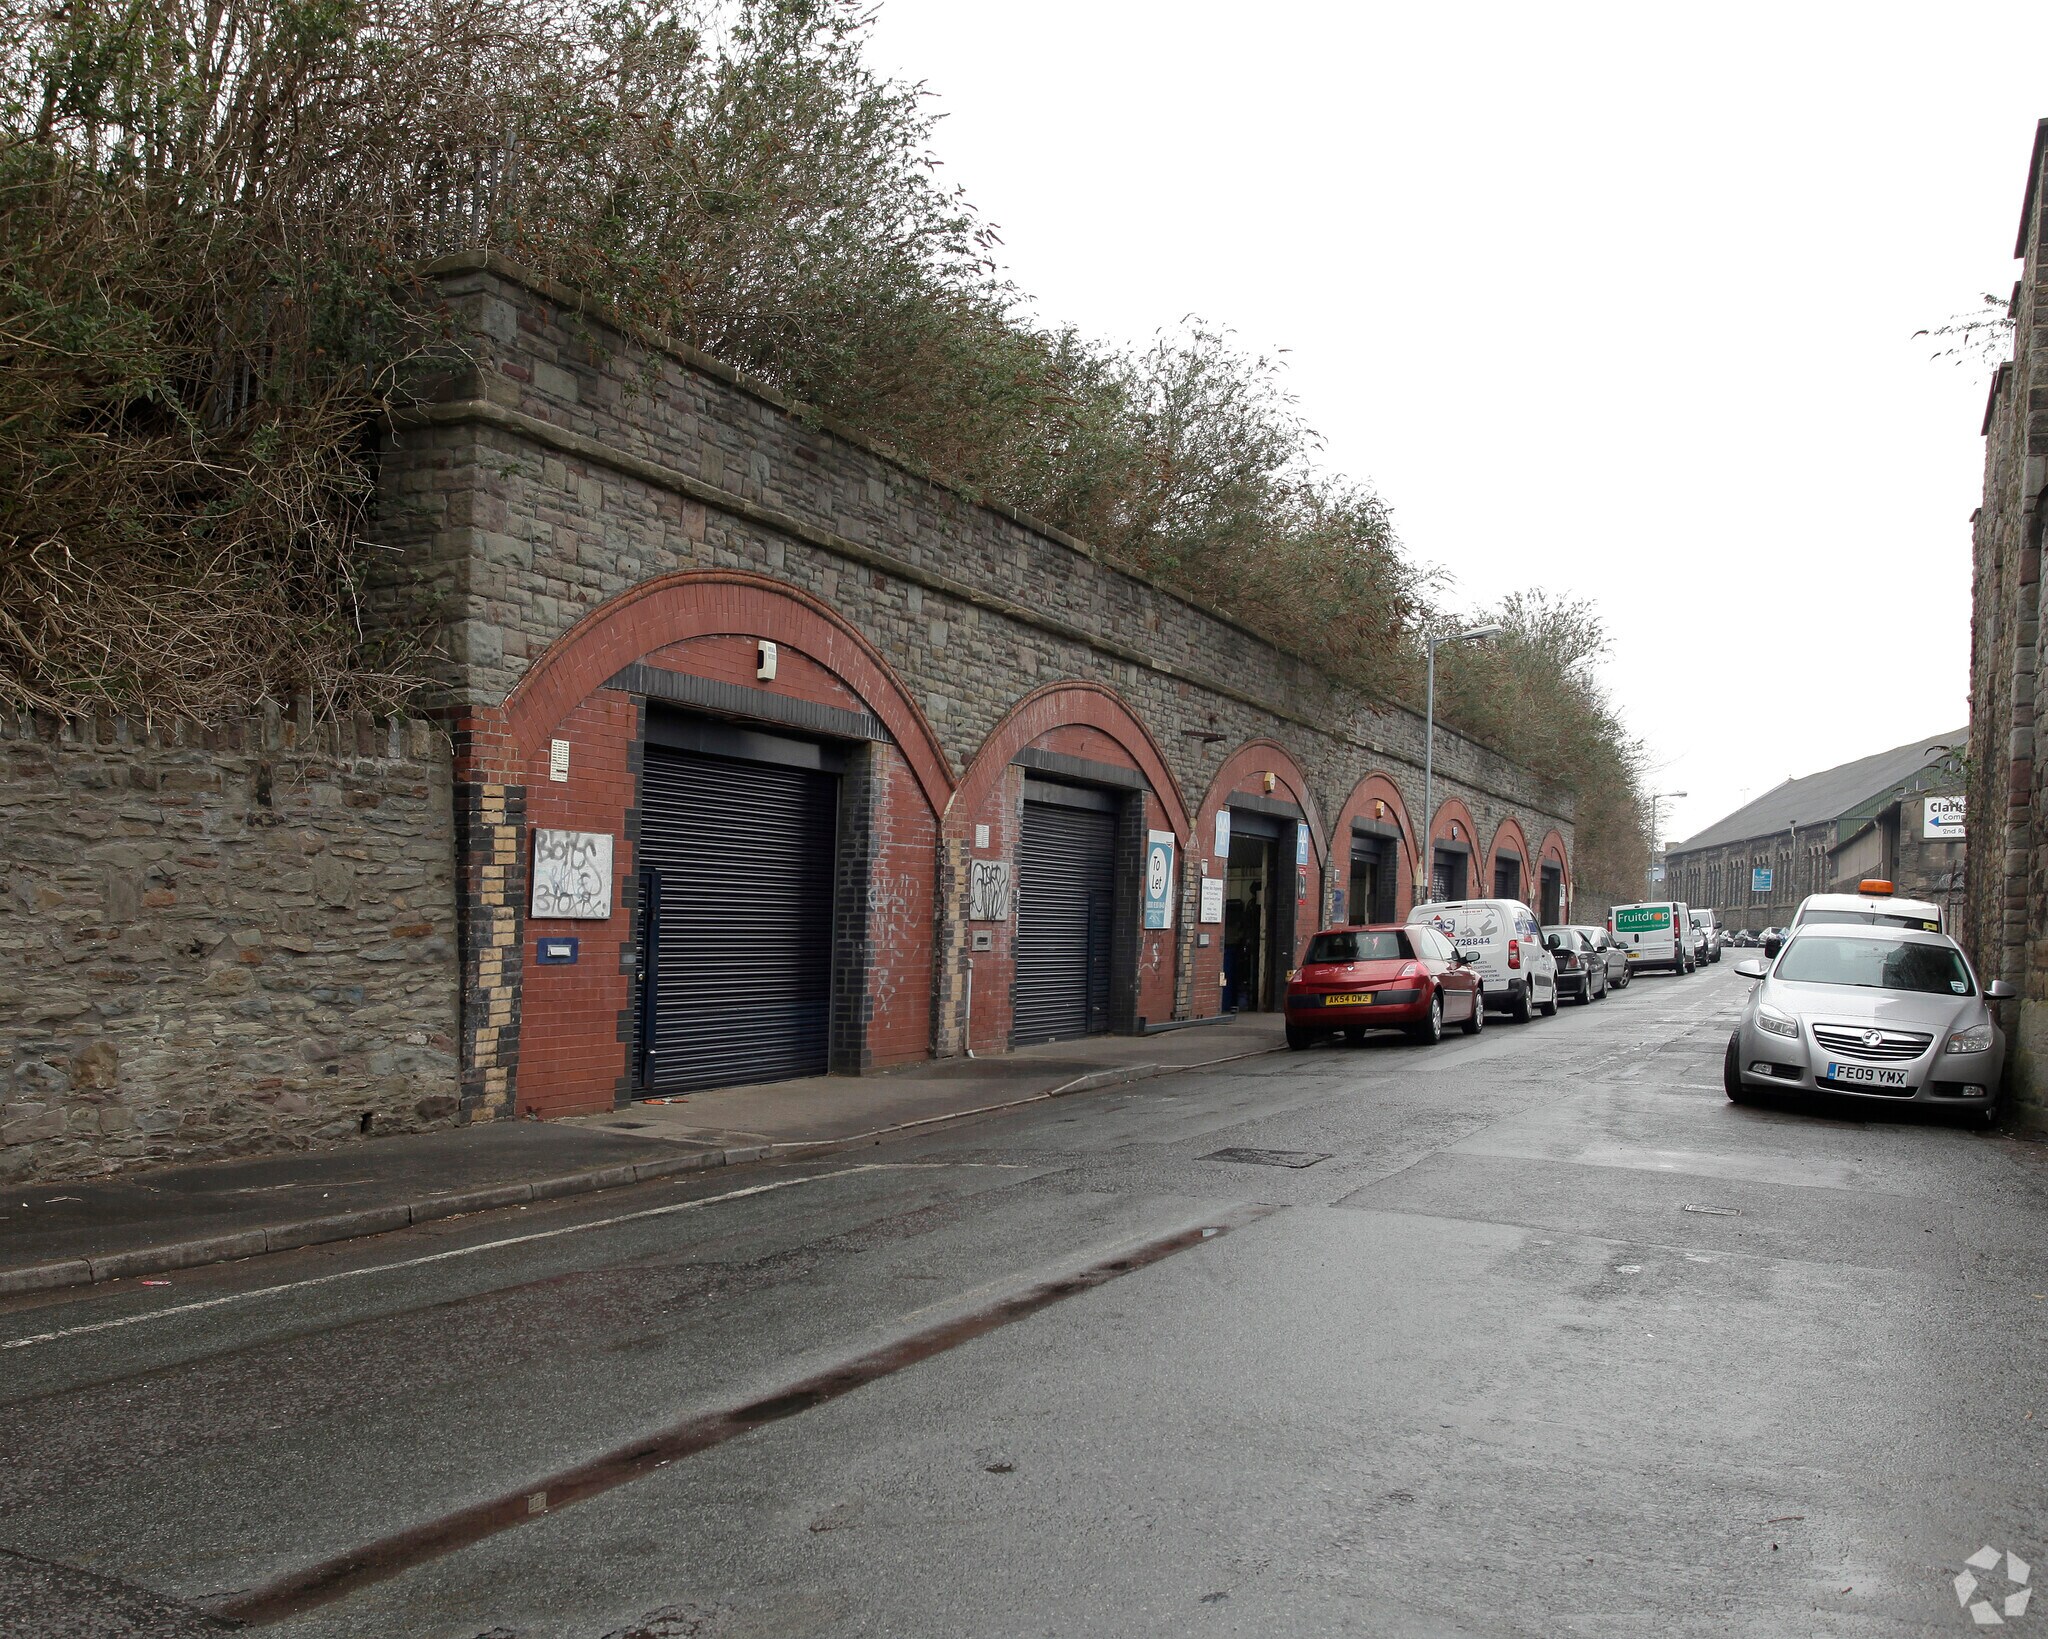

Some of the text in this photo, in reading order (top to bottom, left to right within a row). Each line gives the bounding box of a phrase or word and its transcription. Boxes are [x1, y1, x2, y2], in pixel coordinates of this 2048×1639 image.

[1153, 856, 1161, 871] To
[1151, 875, 1162, 890] Let
[1618, 911, 1669, 922] Fruitdrop
[1455, 938, 1490, 946] 728844
[1329, 995, 1350, 1003] AK54
[1837, 1065, 1906, 1085] FE09 YMX
